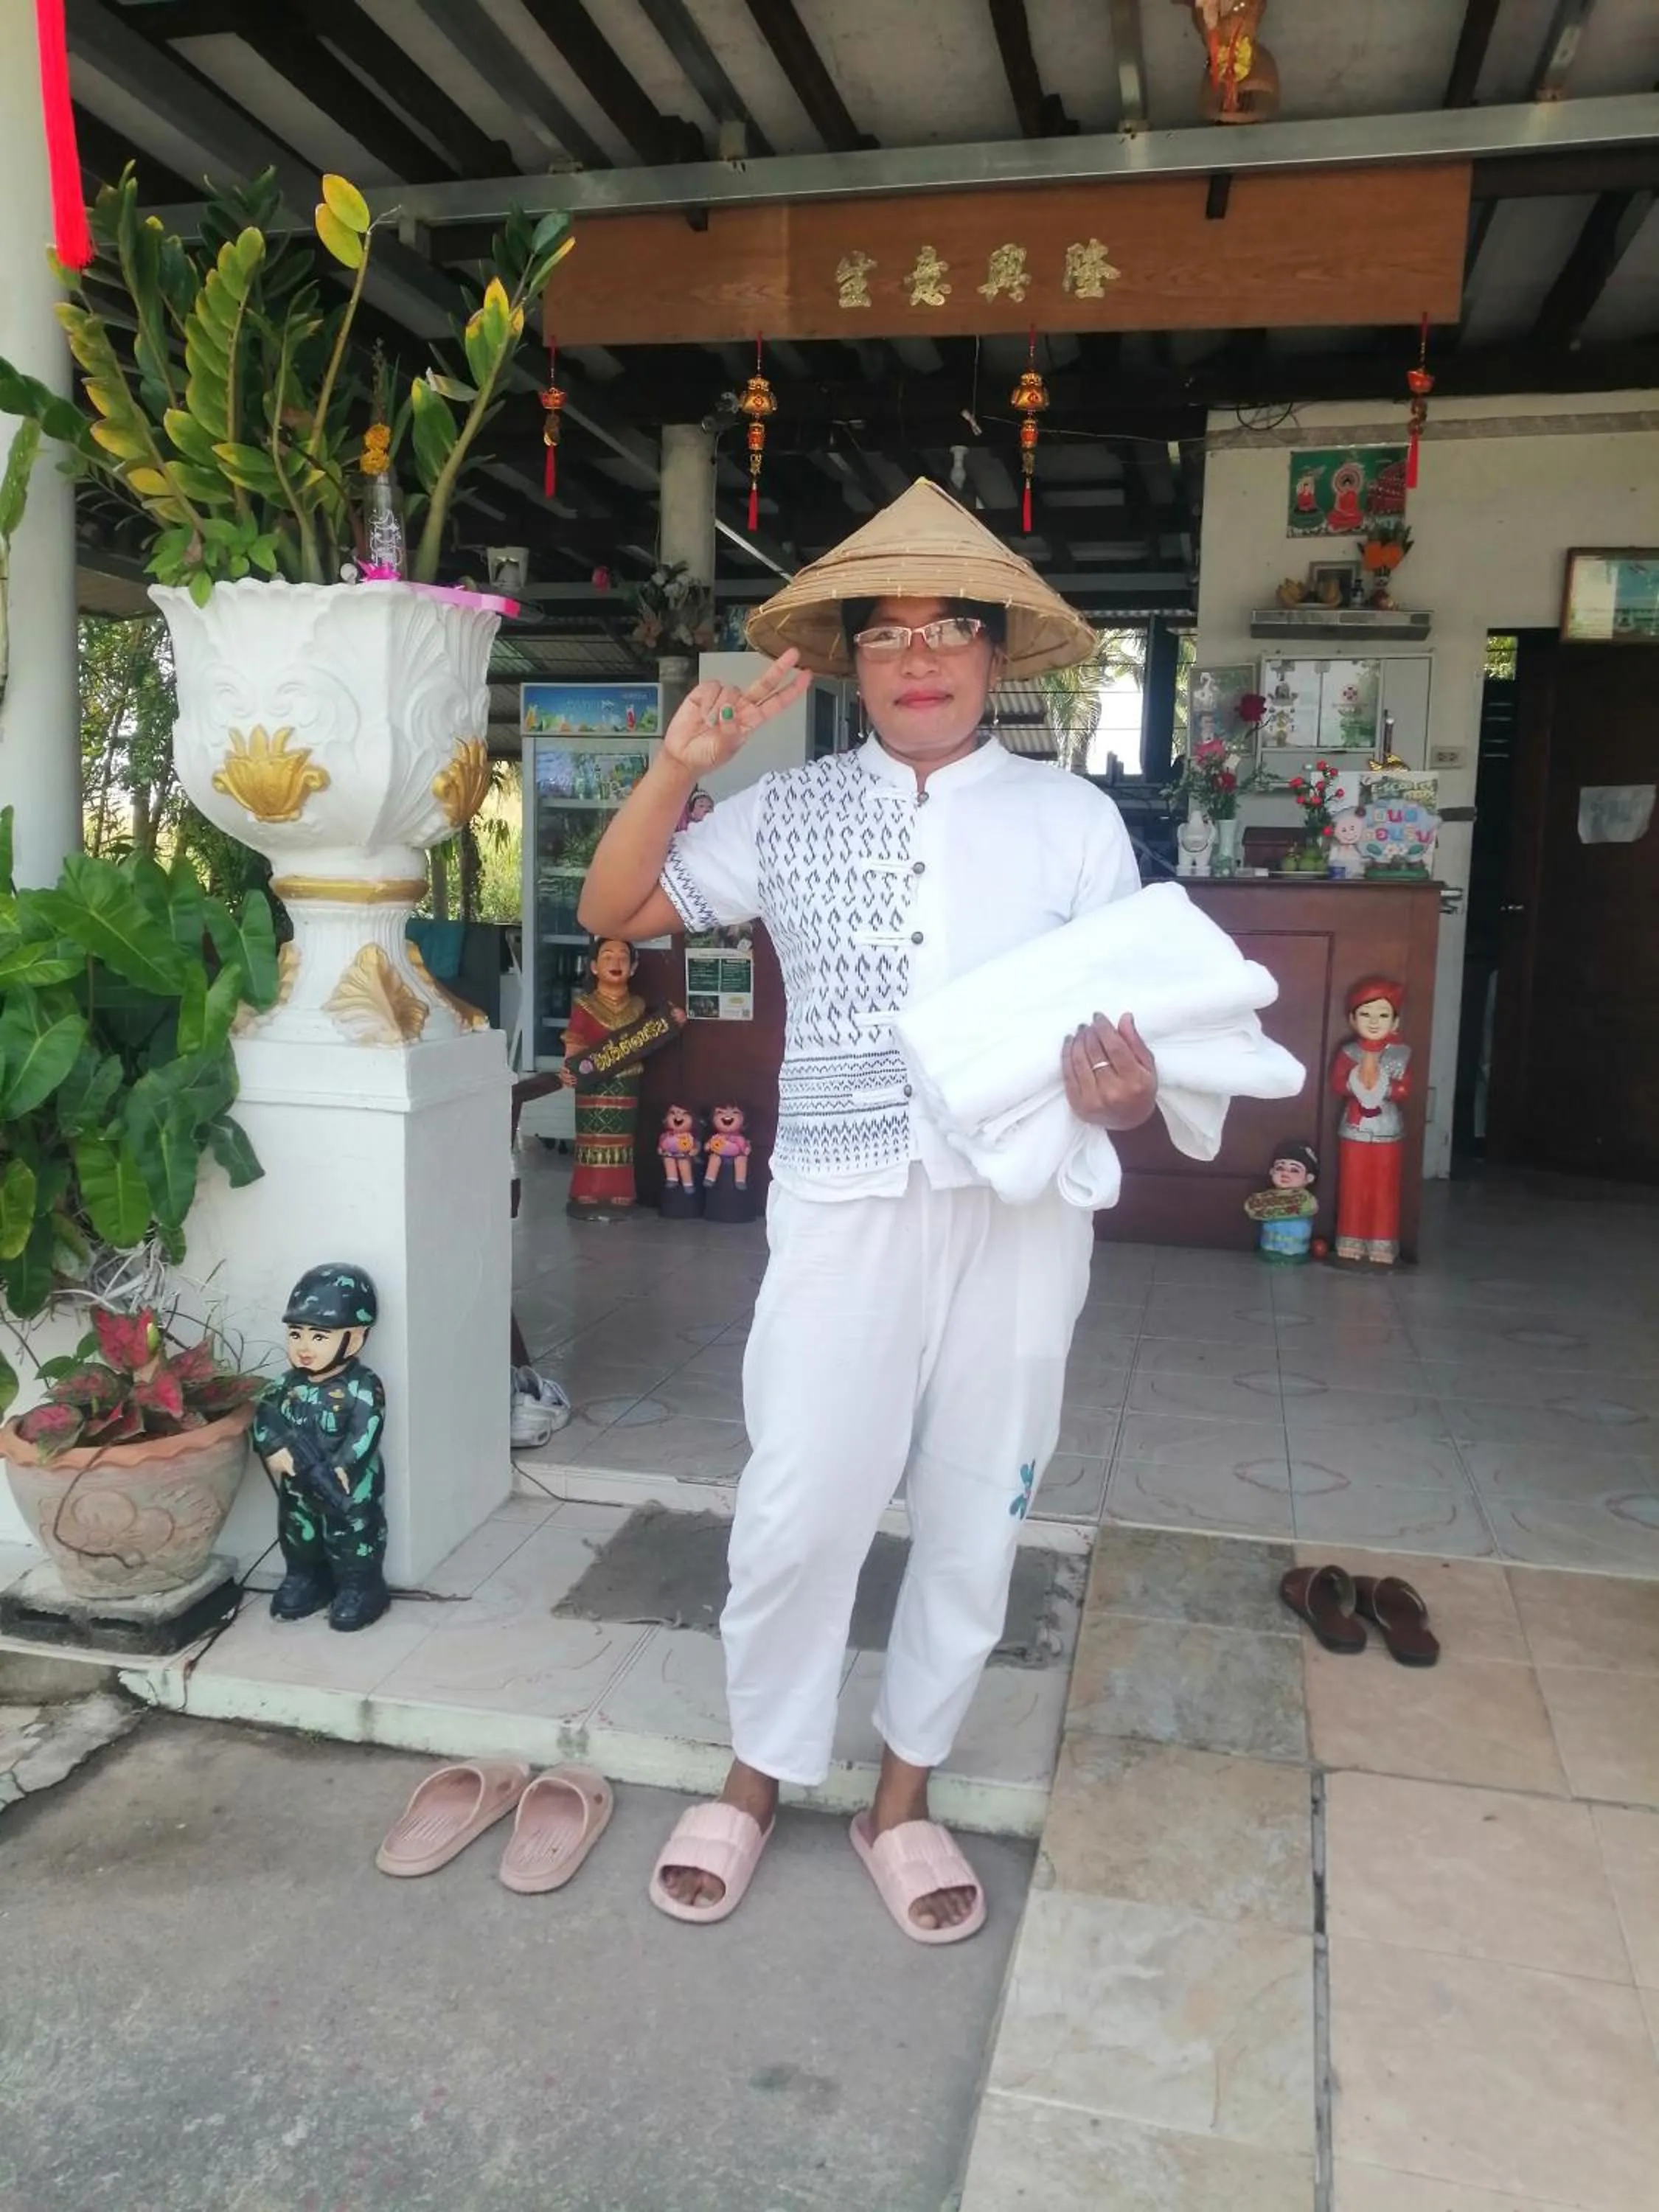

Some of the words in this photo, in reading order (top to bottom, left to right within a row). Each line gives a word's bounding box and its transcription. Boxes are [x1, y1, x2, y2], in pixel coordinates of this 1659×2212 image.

[589, 1018, 669, 1071] ยินดีต้อนรับ
